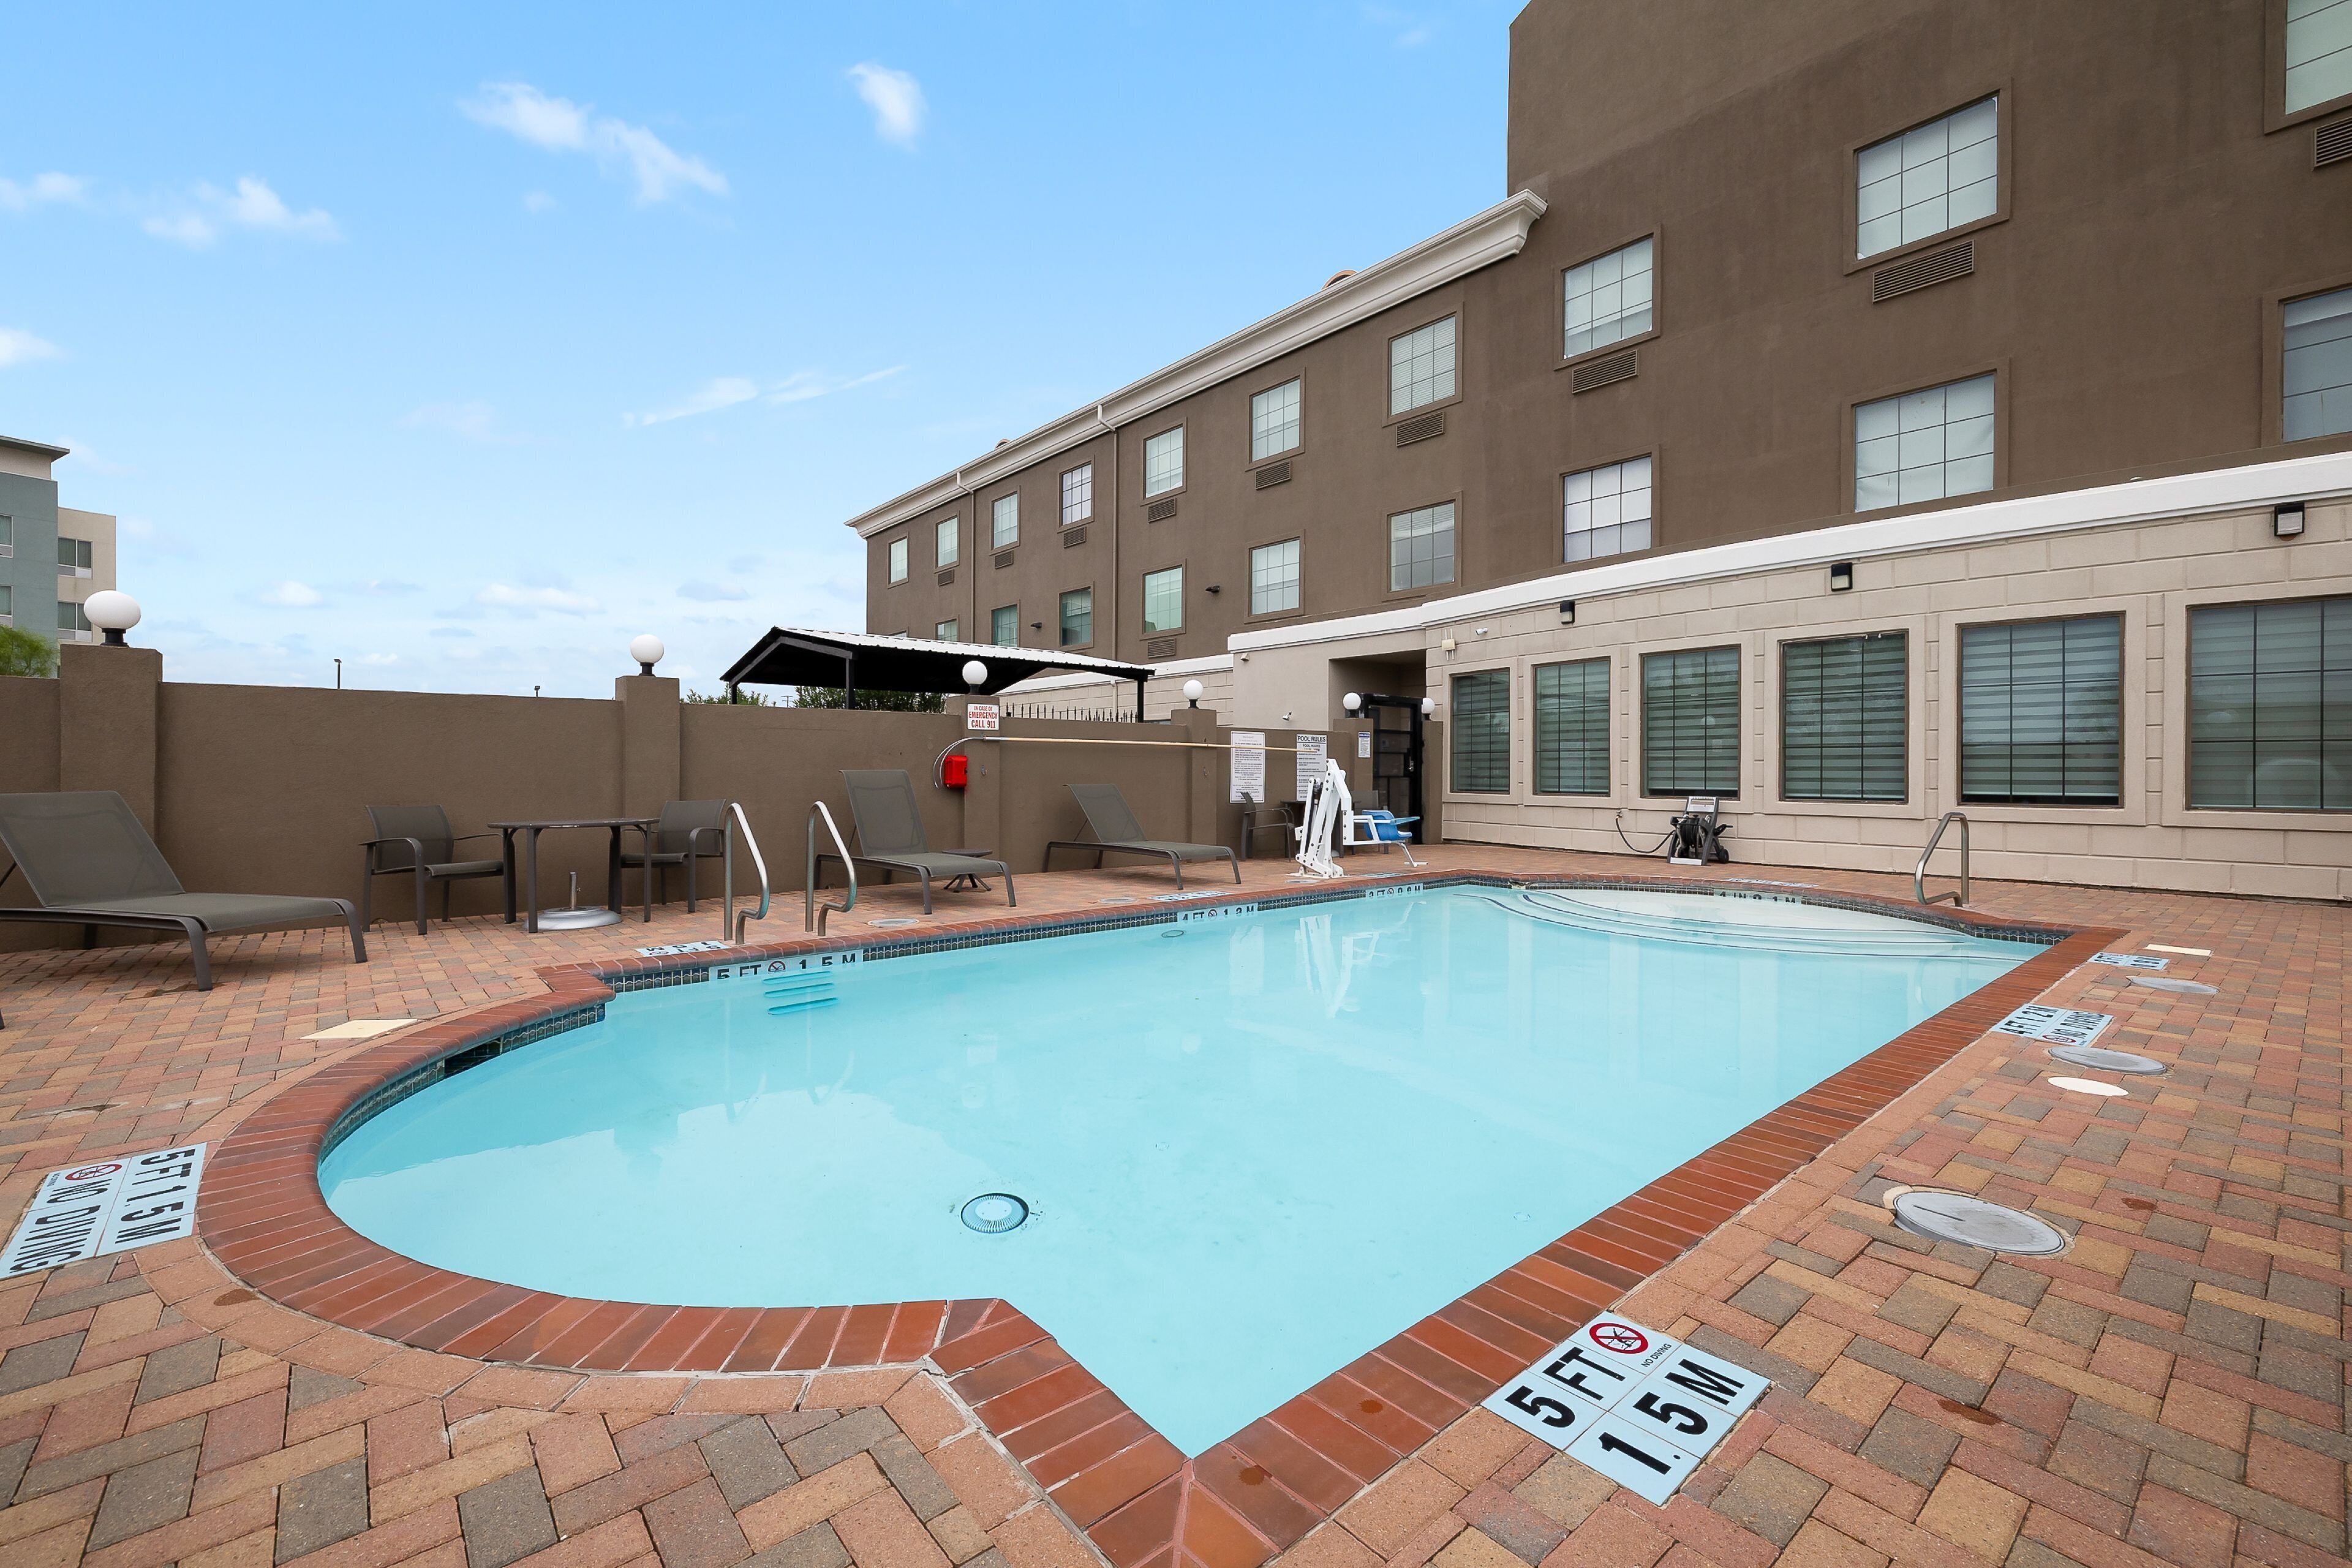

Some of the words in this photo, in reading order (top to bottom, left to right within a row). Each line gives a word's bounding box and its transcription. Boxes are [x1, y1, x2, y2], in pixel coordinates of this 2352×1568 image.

[987, 720, 995, 729] 911
[842, 953, 856, 963] M
[717, 968, 730, 979] 5
[739, 964, 762, 978] FT
[140, 1148, 196, 1166] 5
[132, 1163, 192, 1186] FT
[47, 1178, 113, 1204] NO
[9, 1204, 101, 1273] DIVING
[115, 1218, 182, 1245] M
[1641, 1356, 1654, 1368] NO
[1651, 1343, 1672, 1359] DIVING
[1504, 1385, 1576, 1428] 5
[1542, 1346, 1626, 1401] FT
[1664, 1359, 1745, 1406] M
